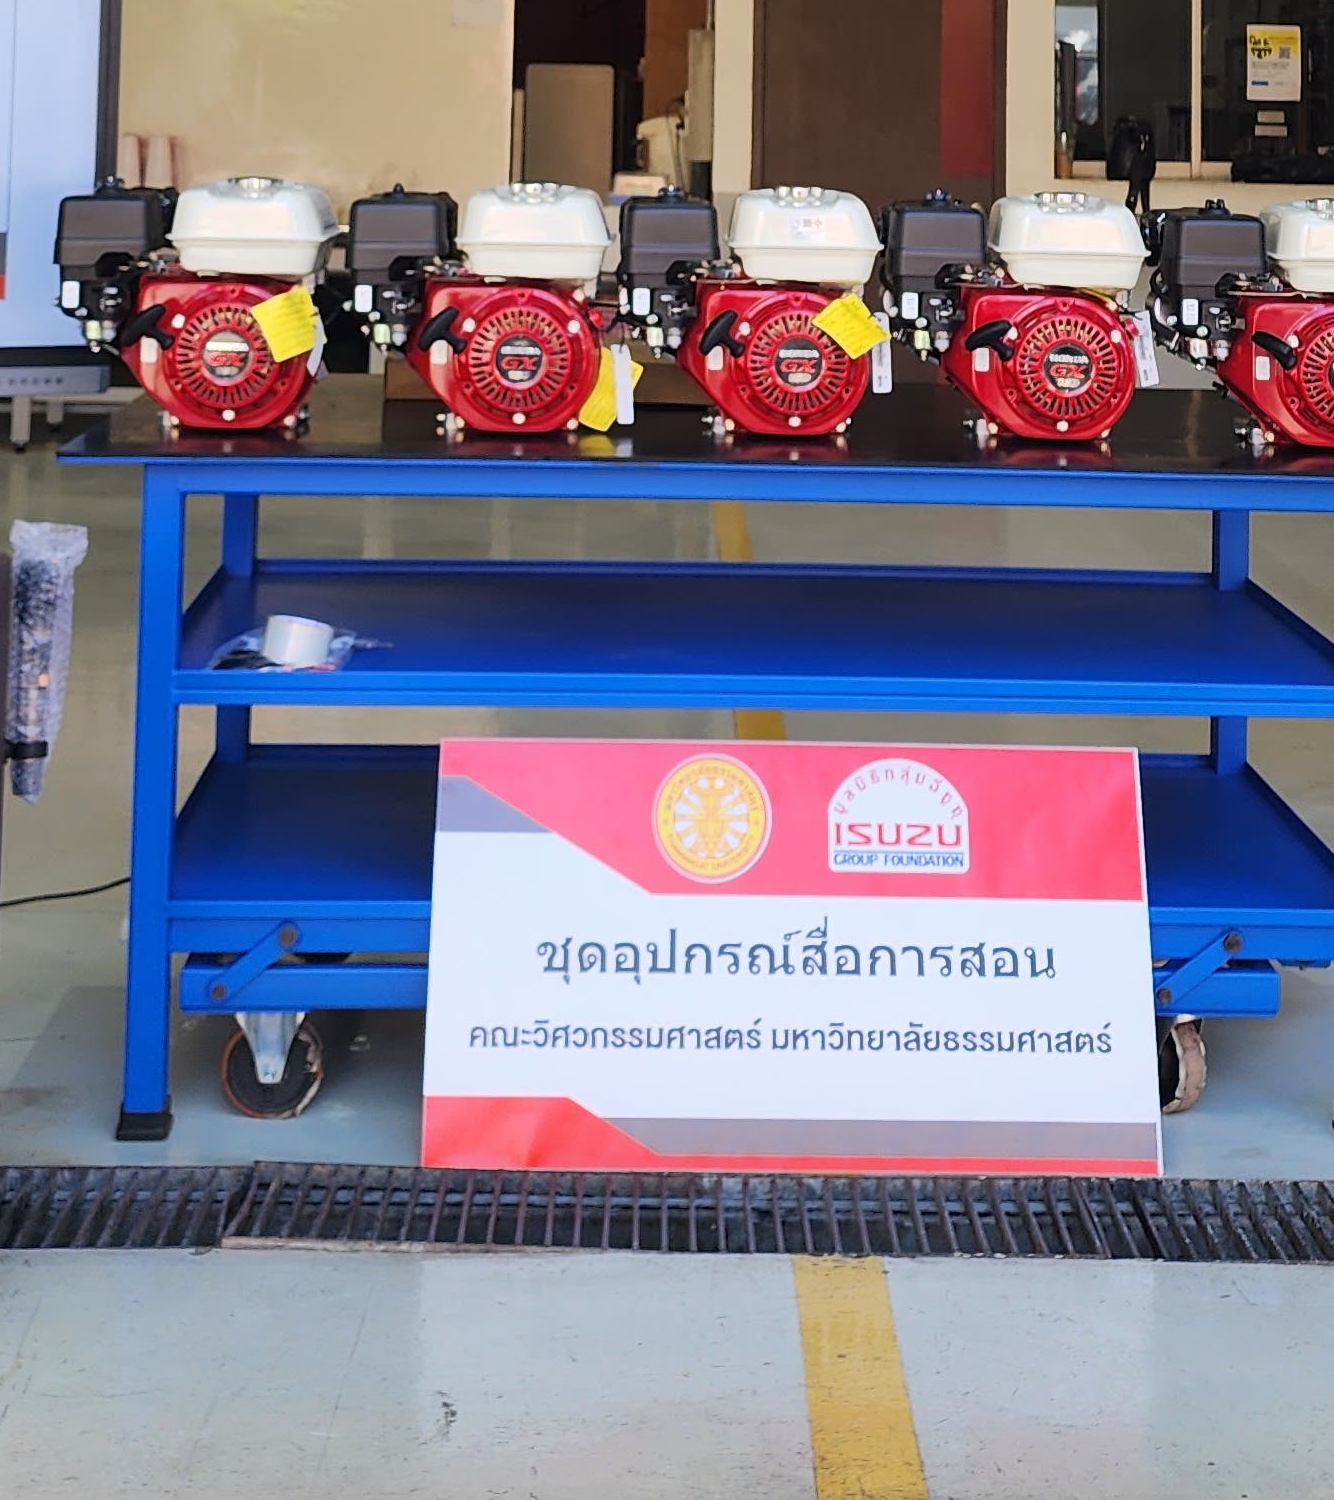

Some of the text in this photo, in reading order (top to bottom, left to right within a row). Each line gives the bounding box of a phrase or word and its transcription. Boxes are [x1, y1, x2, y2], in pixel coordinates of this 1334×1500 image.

[501, 356, 539, 370] GX
[780, 359, 817, 373] GX
[1050, 363, 1086, 378] GX
[835, 823, 961, 846] ISUZU
[834, 854, 964, 867] GROUP FOUNDATION
[537, 916, 1055, 984] ชุดอุปกรณ์สื่อการสอน
[469, 1017, 1112, 1053] คณะวิศวกรรมศาสตร์ มหาวิทยาลัยธรรมศาสตร์
